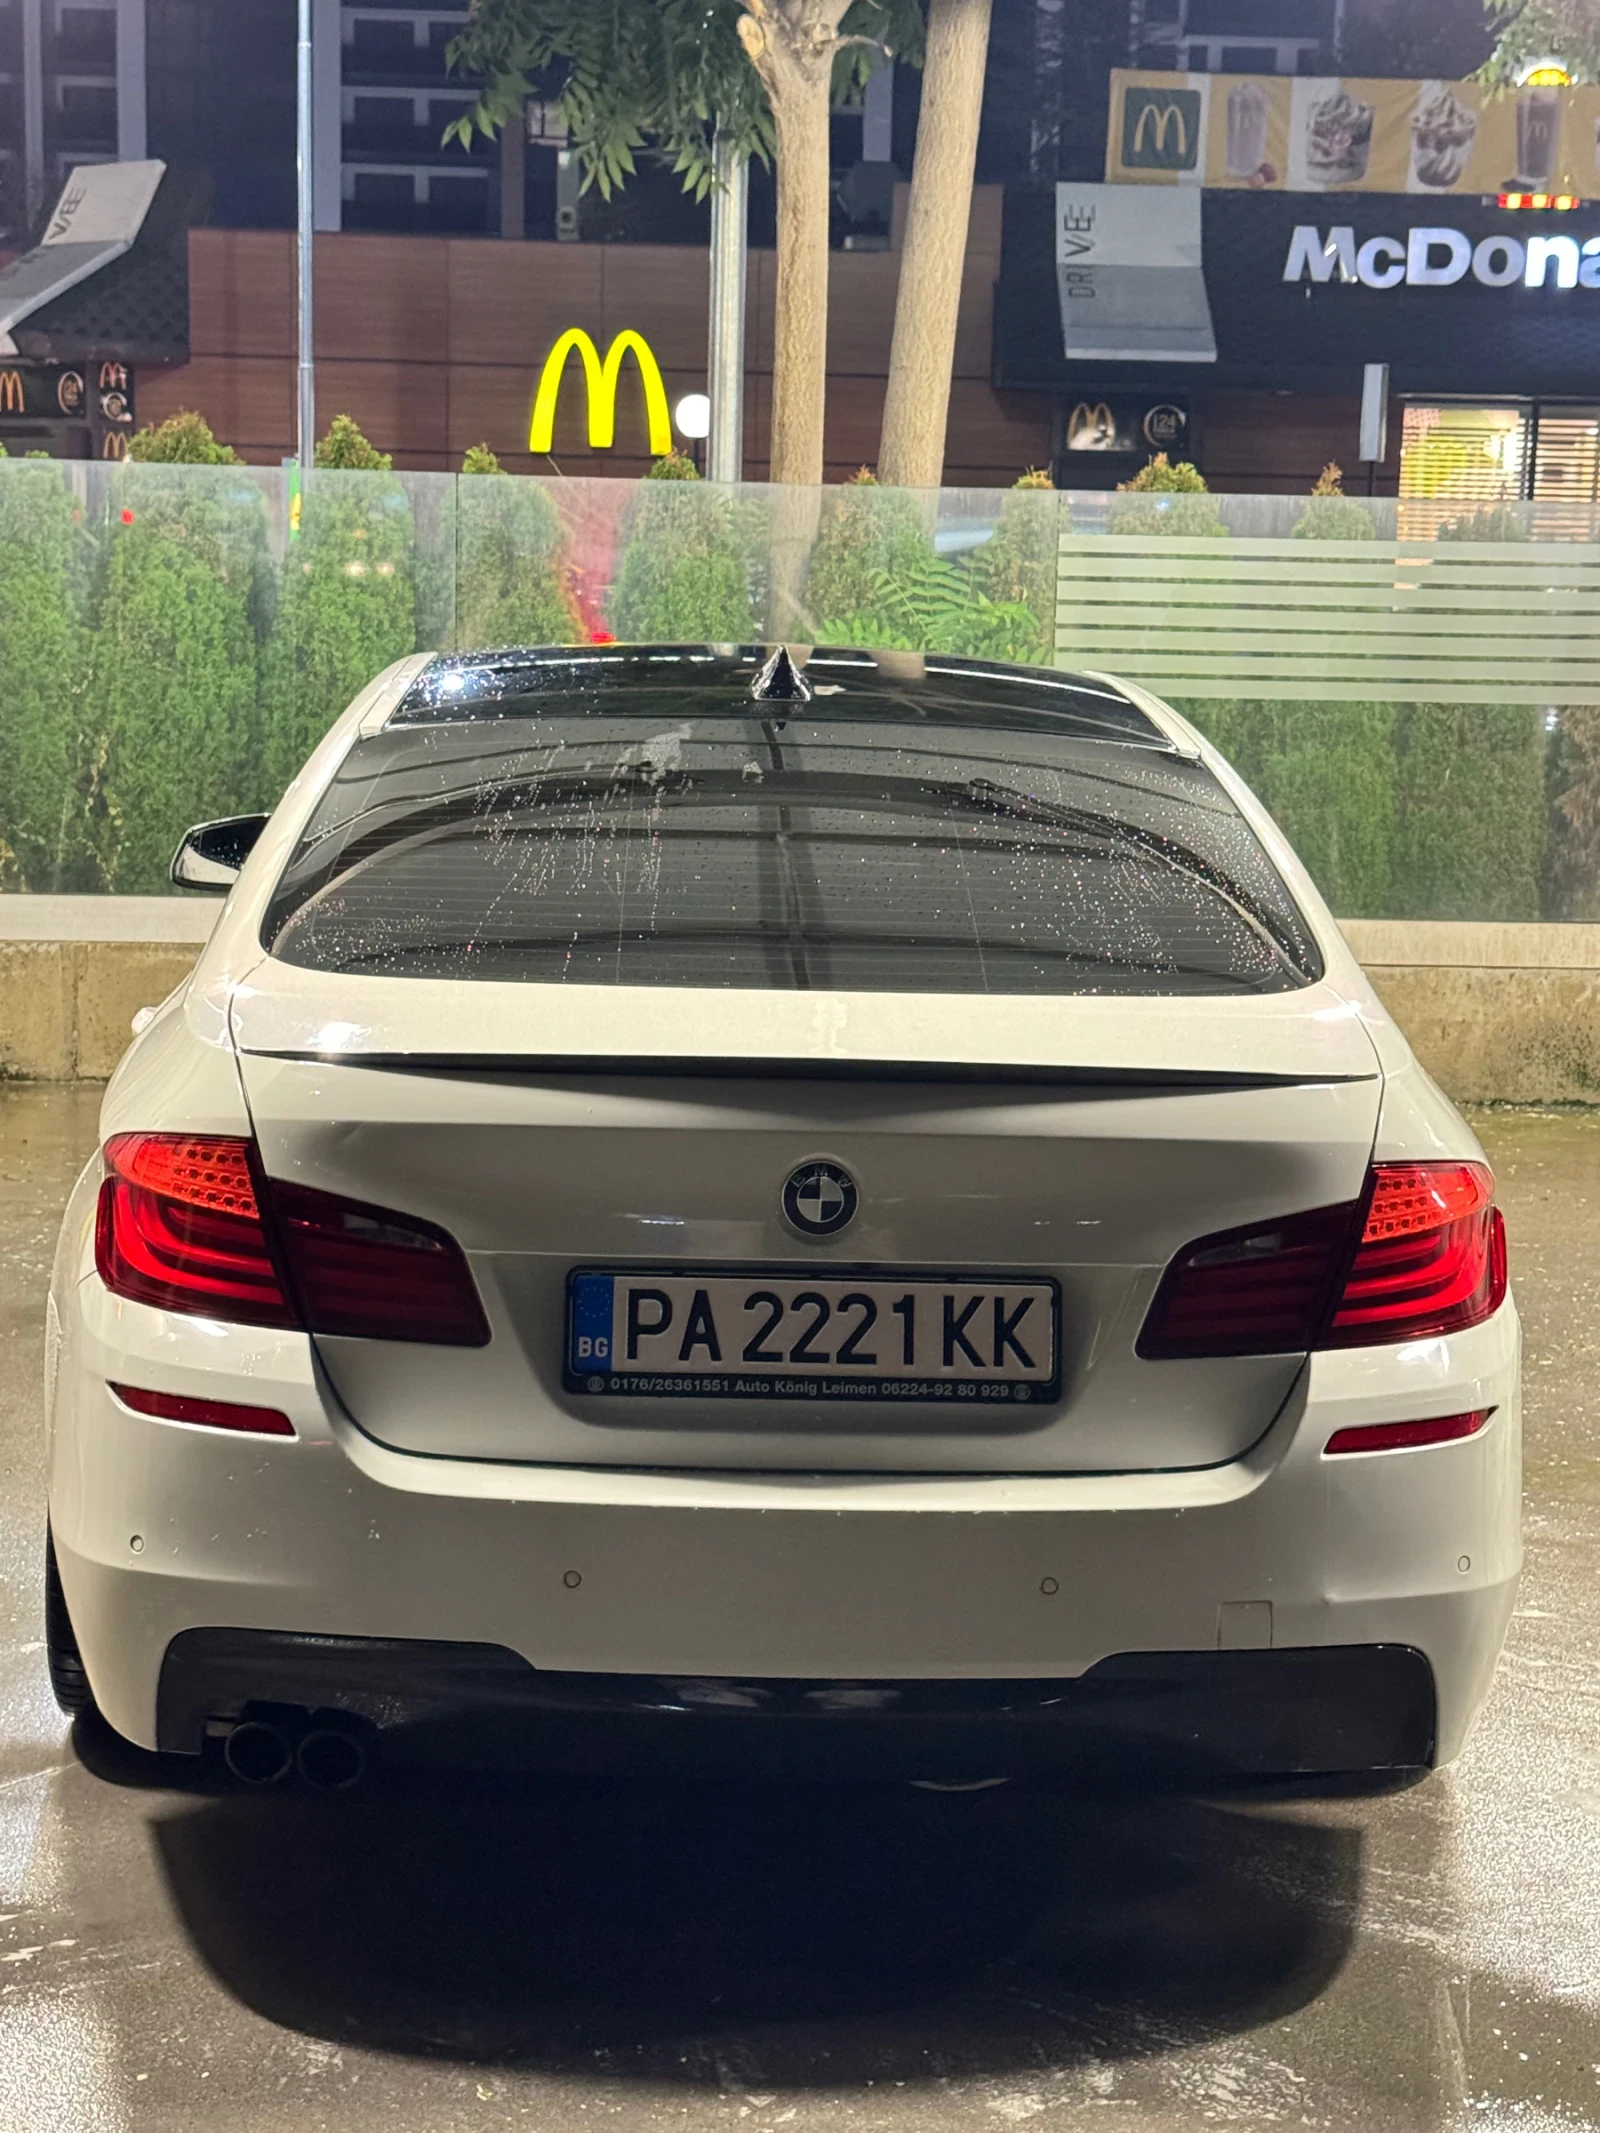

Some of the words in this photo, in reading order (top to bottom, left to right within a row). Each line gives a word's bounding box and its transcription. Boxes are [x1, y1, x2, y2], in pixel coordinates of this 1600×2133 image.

[1064, 206, 1096, 299] DRIVE
[578, 1336, 609, 1358] BG
[626, 1288, 724, 1361] PA
[742, 1291, 915, 1366] 2221
[942, 1295, 1038, 1369] KK
[610, 1377, 729, 1392] 0176/26361551
[734, 1380, 770, 1393] Auto
[775, 1379, 818, 1395] König
[822, 1381, 877, 1395] Leimen
[881, 1382, 953, 1396] 06224-92
[958, 1383, 977, 1396] 80
[981, 1384, 1010, 1397] 929
